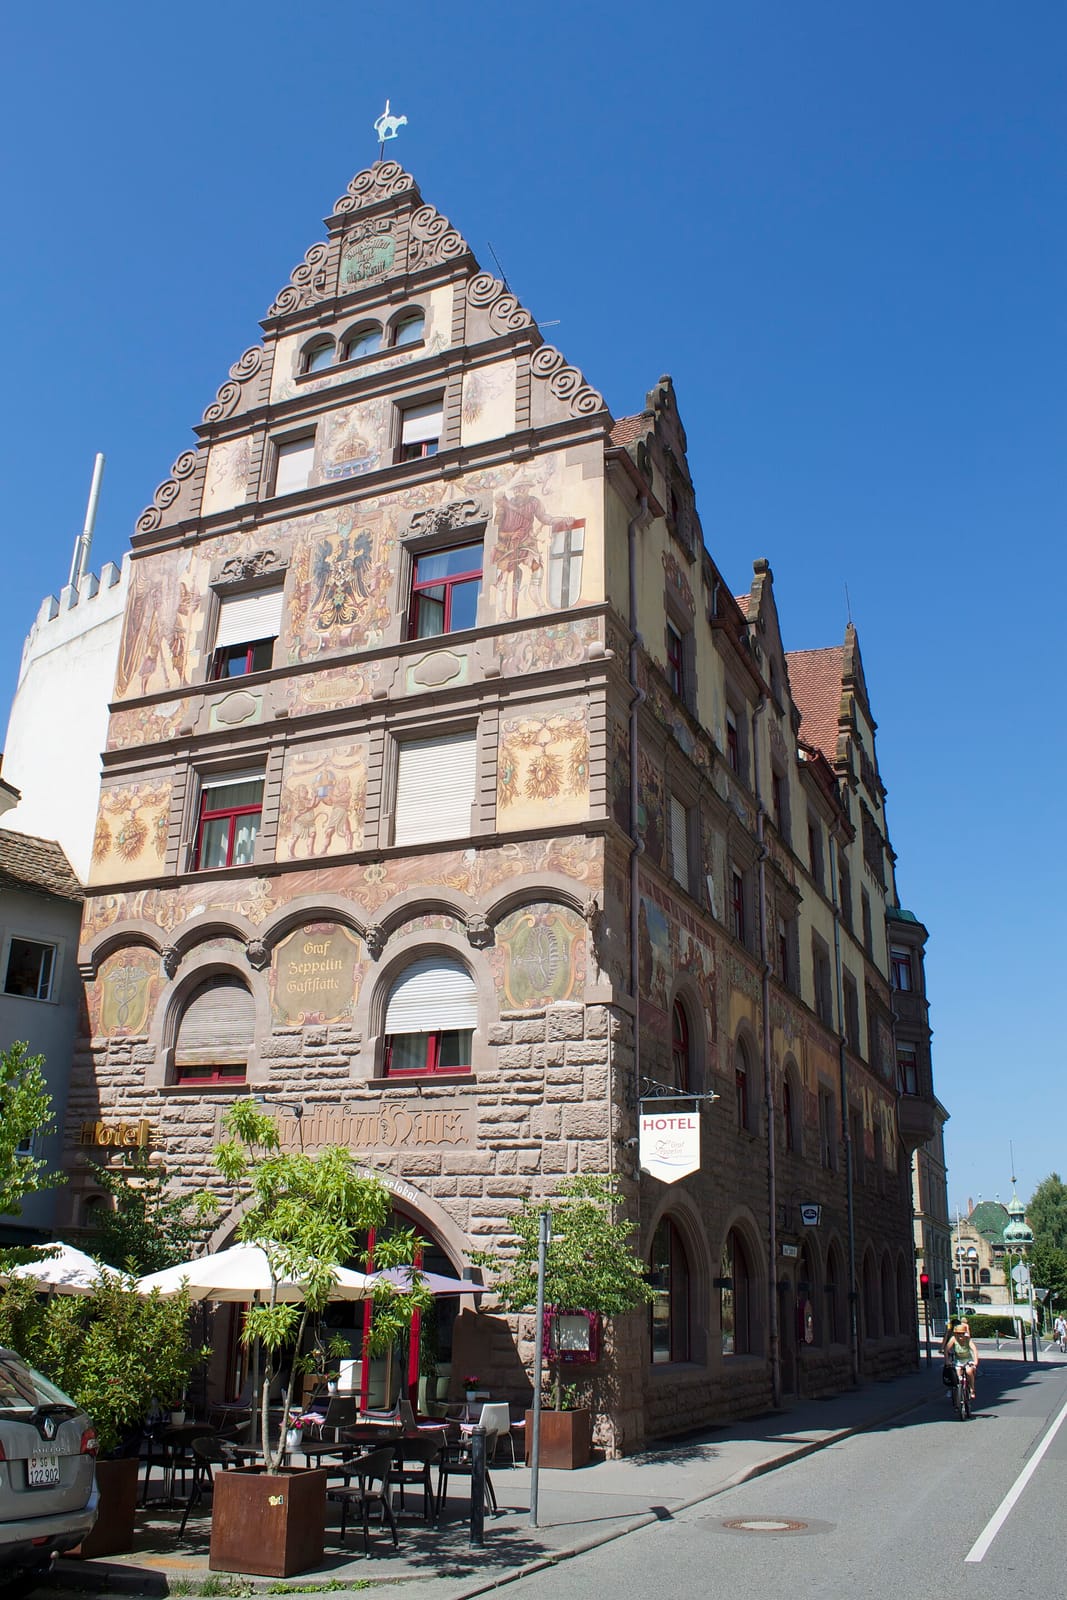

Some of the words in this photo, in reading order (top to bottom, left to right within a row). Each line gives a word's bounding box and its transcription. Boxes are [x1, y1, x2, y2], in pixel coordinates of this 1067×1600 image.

[303, 941, 332, 956] Graf
[288, 958, 343, 975] Zeppelin
[643, 1118, 697, 1131] HOTEL
[80, 1119, 150, 1147] Hotel
